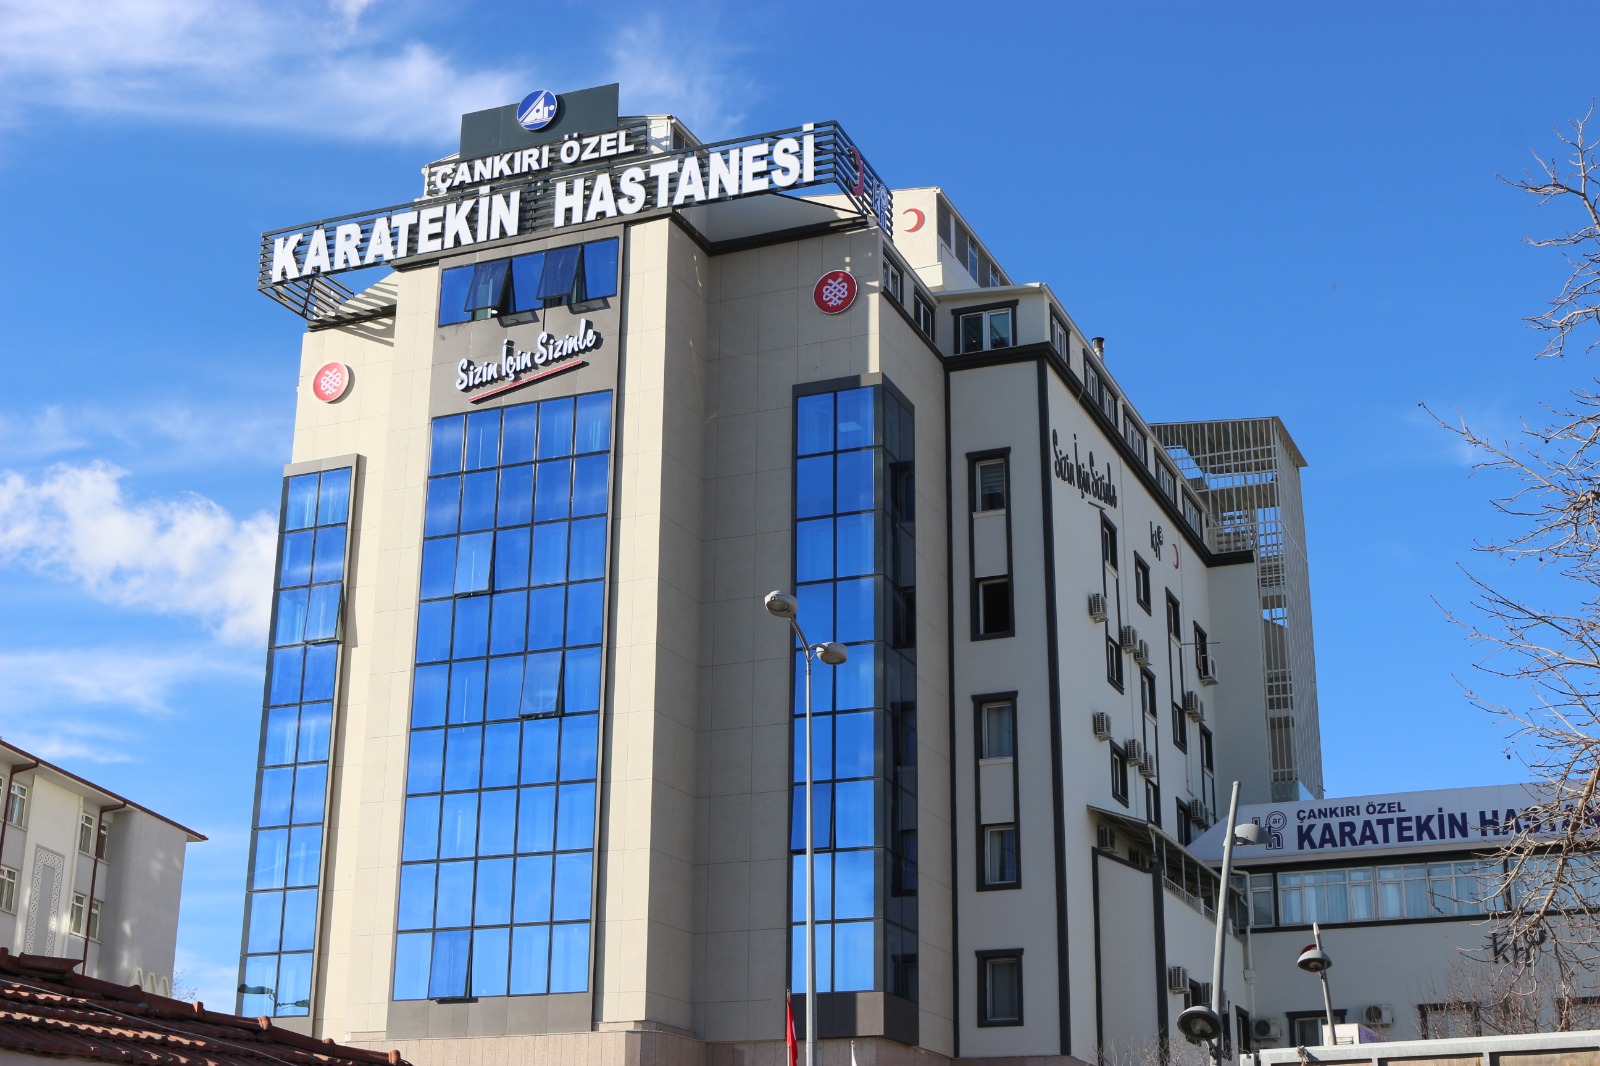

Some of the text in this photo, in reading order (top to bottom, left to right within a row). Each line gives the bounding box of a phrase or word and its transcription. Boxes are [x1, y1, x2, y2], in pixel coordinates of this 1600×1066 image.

[435, 131, 634, 195] ÇANKIRI ÖZEL
[272, 123, 815, 283] KARATEKİN HASTANESİ
[456, 318, 596, 391] Sizin İçin Sizinle
[1053, 429, 1075, 487] Sizin
[1089, 451, 1117, 509] Sizinle
[1297, 802, 1406, 822] ÇANKIRI ÖZEL
[1297, 808, 1469, 850] KARATEKİN
